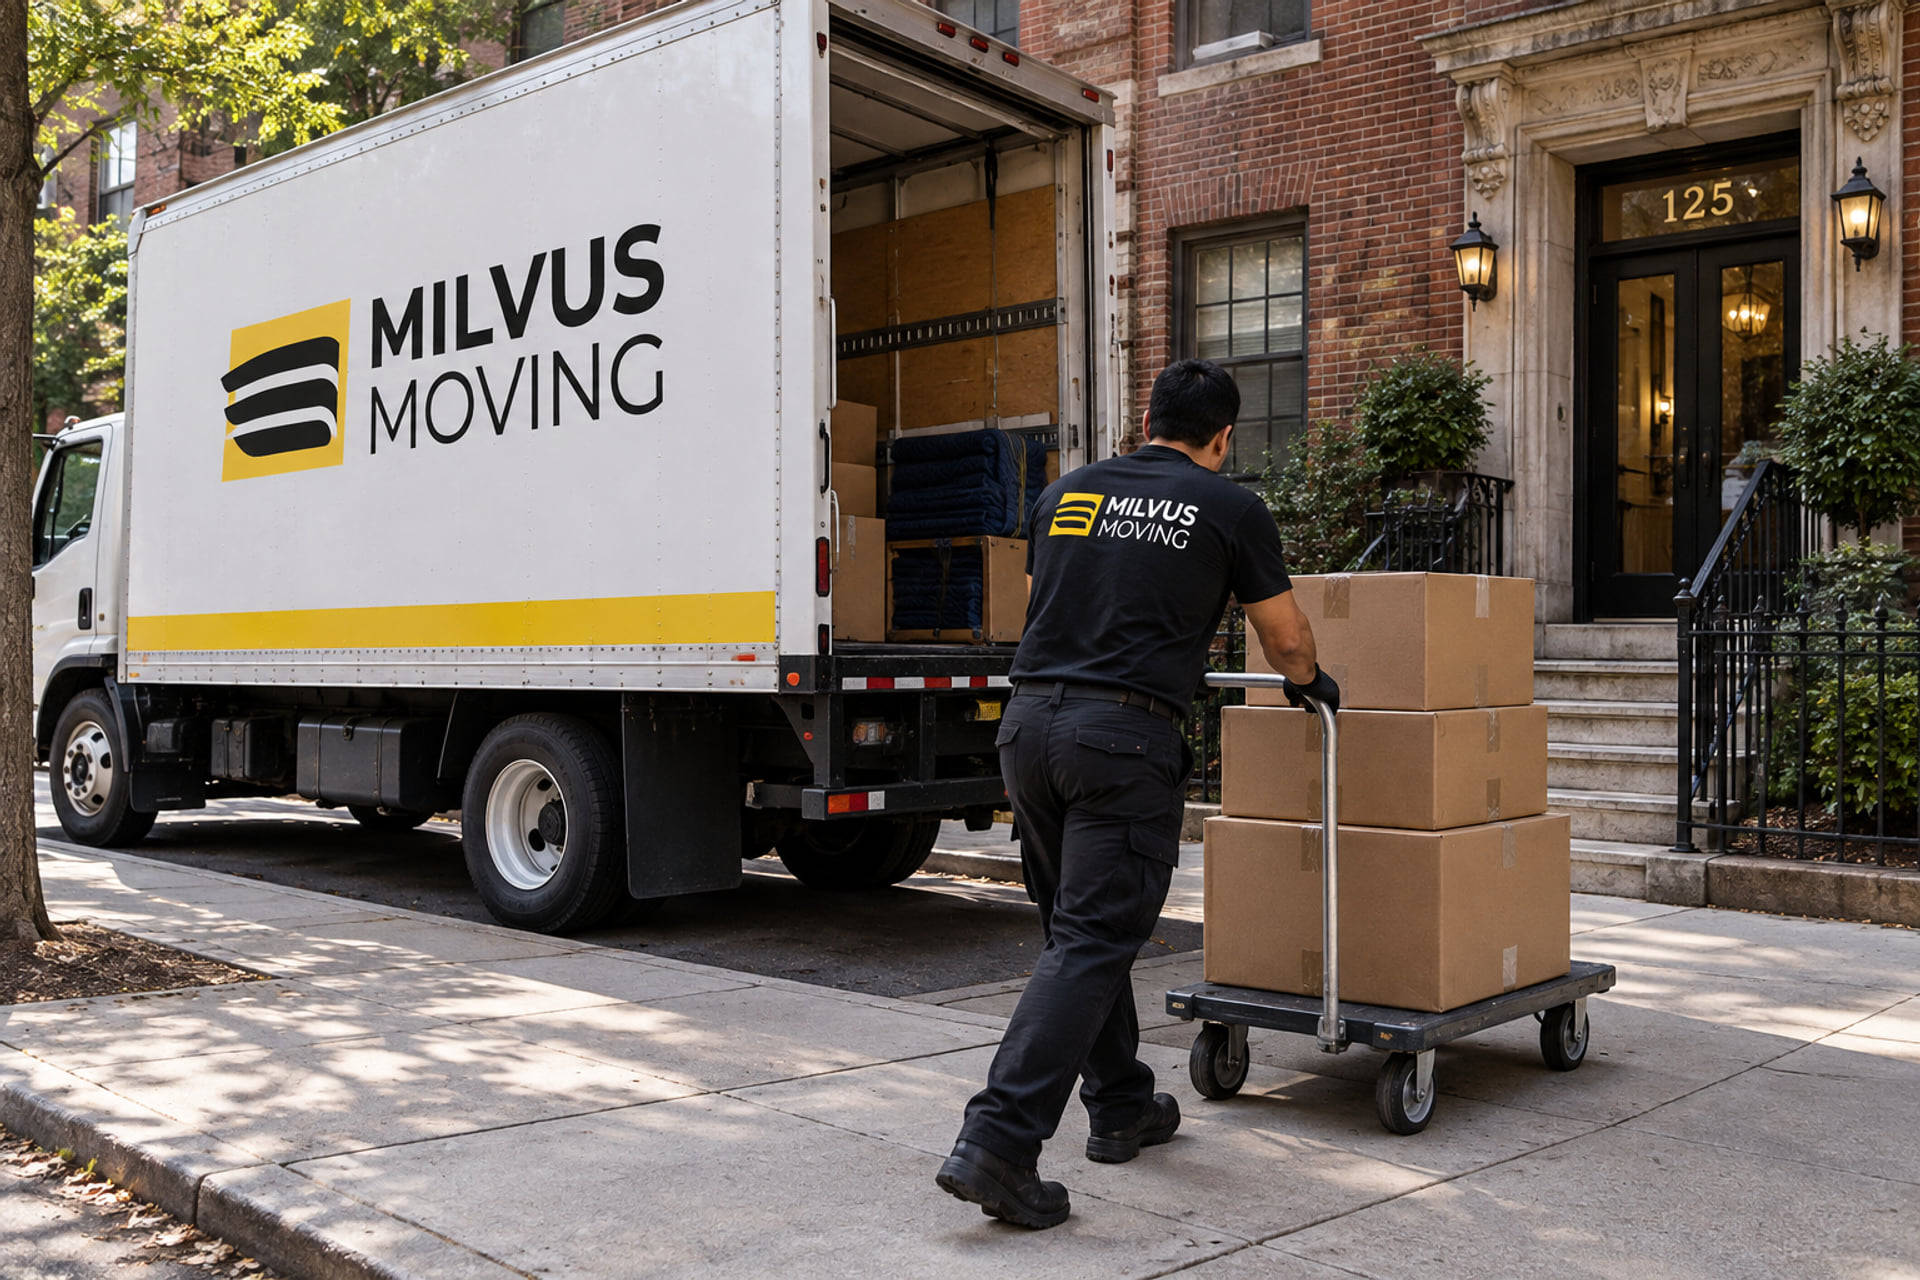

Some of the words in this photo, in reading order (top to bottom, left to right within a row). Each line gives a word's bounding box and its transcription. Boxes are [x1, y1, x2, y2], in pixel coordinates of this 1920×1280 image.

[1662, 180, 1734, 223] 125
[371, 223, 665, 369] MILVUS
[370, 333, 664, 455] MOVING
[1105, 496, 1199, 527] MILVUS
[1097, 518, 1190, 549] MOVING
